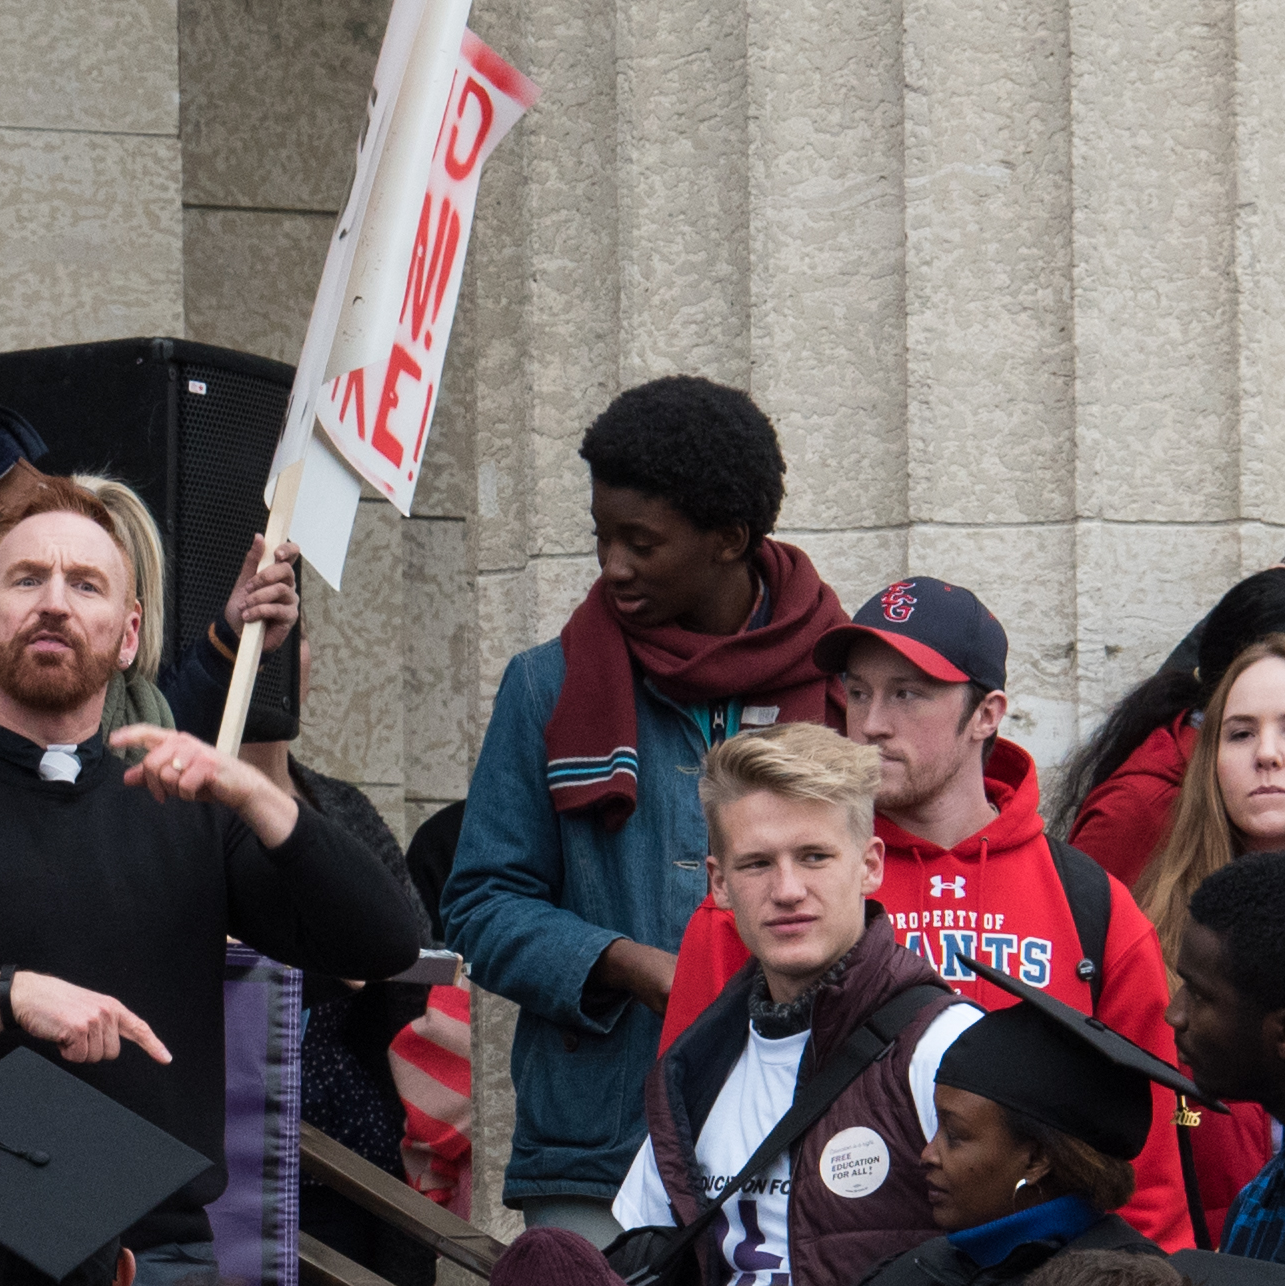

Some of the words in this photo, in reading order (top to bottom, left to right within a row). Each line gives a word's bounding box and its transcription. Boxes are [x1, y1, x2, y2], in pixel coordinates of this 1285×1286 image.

[983, 913, 1004, 930] OF
[831, 1152, 852, 1164] FREE
[832, 1155, 880, 1172] EDUCATION
[832, 1170, 849, 1180] FOR
[770, 1179, 792, 1195] FO
